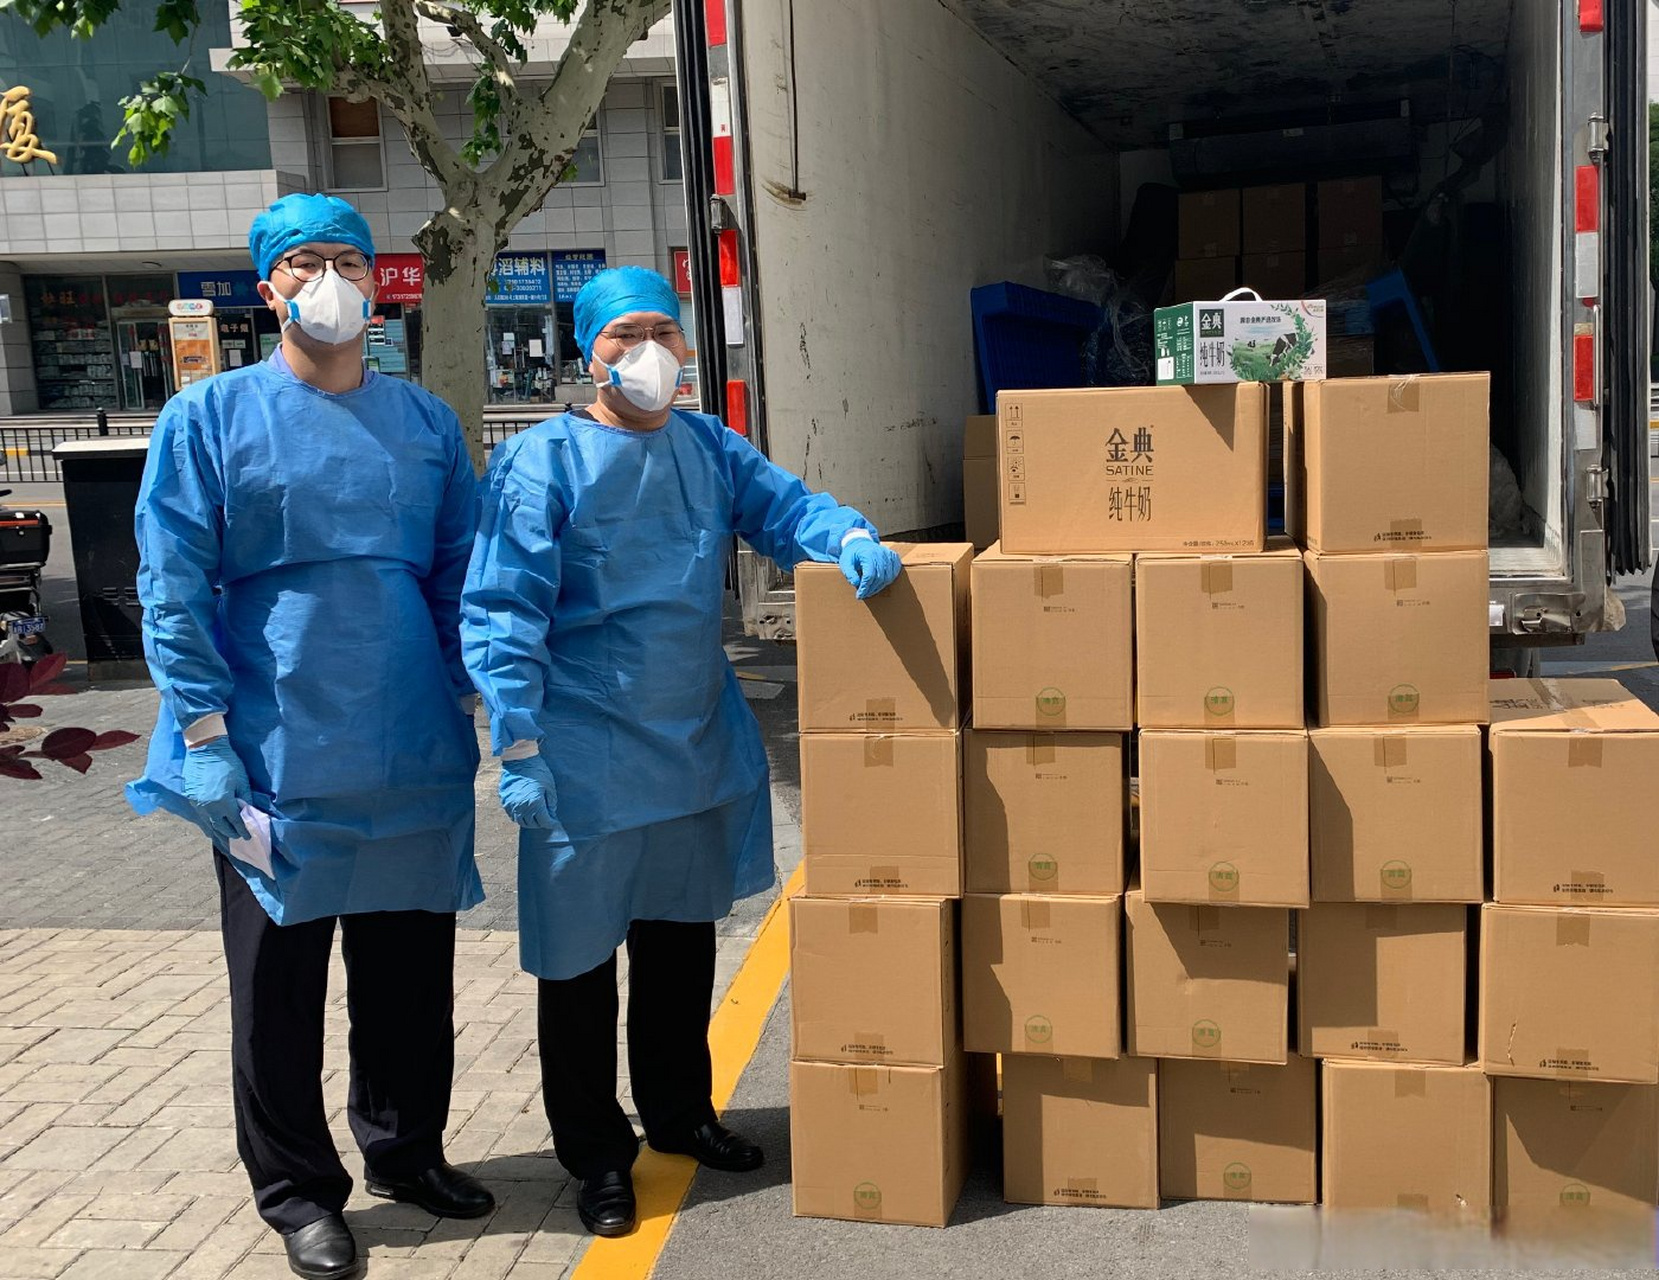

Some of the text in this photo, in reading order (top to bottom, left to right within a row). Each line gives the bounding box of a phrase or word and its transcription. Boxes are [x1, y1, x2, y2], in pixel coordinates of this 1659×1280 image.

[380, 267, 421, 286] 沪华
[200, 281, 232, 297] 雪加
[1200, 312, 1222, 331] 金典
[1199, 341, 1225, 368] 纯牛奶
[1105, 427, 1154, 463] 金典
[1106, 465, 1154, 476] SATINE
[1108, 486, 1152, 522] 纯牛奶
